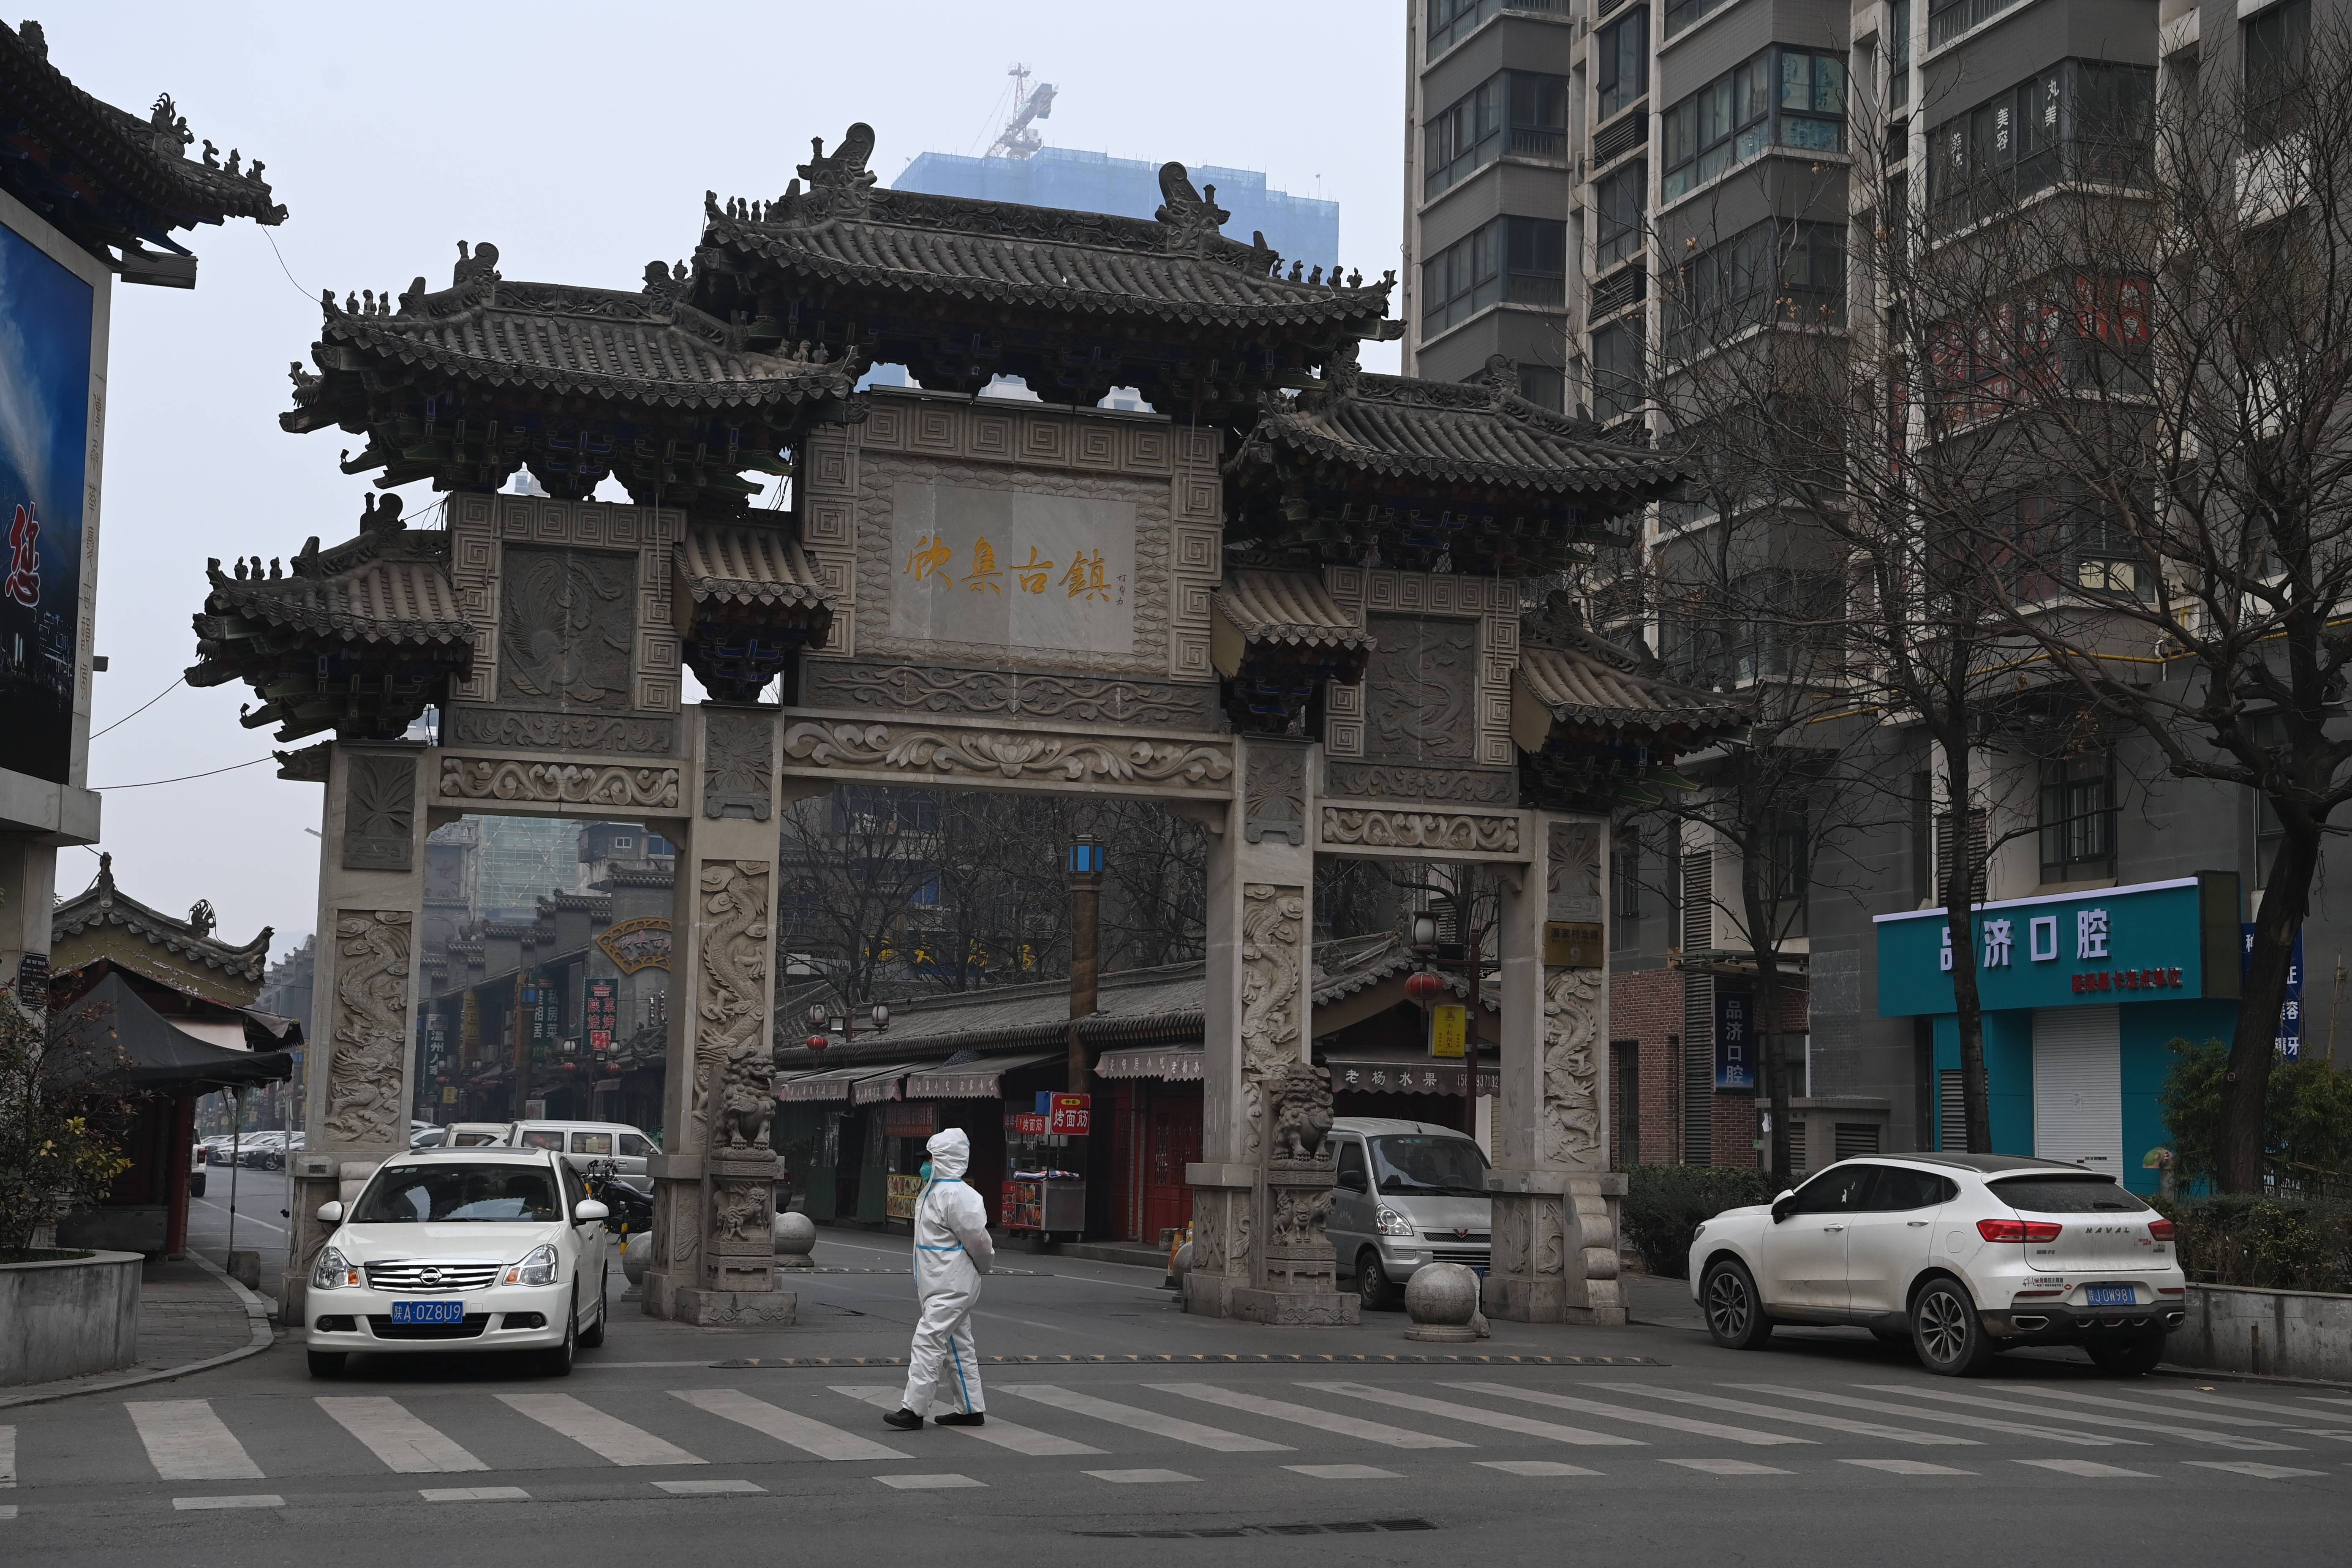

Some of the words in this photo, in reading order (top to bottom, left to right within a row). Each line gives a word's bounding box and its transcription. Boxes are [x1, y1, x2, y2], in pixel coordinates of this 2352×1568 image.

[1996, 107, 2009, 152] 美容
[4, 501, 41, 607] 您
[1551, 928, 1599, 940] 潘家村北路
[1570, 947, 1581, 961] 9
[588, 997, 616, 1013] 陕菜
[547, 989, 558, 1039] 私房菜
[587, 1014, 615, 1030] 烧烤
[593, 1032, 608, 1041] 十年
[1725, 1000, 1744, 1085] 品济口腔
[1345, 1068, 1437, 1087] 老杨水果
[1456, 1073, 1499, 1088] 158937132
[1022, 1118, 1043, 1131] 烤面筋
[1053, 1108, 1089, 1128] 烤面筋
